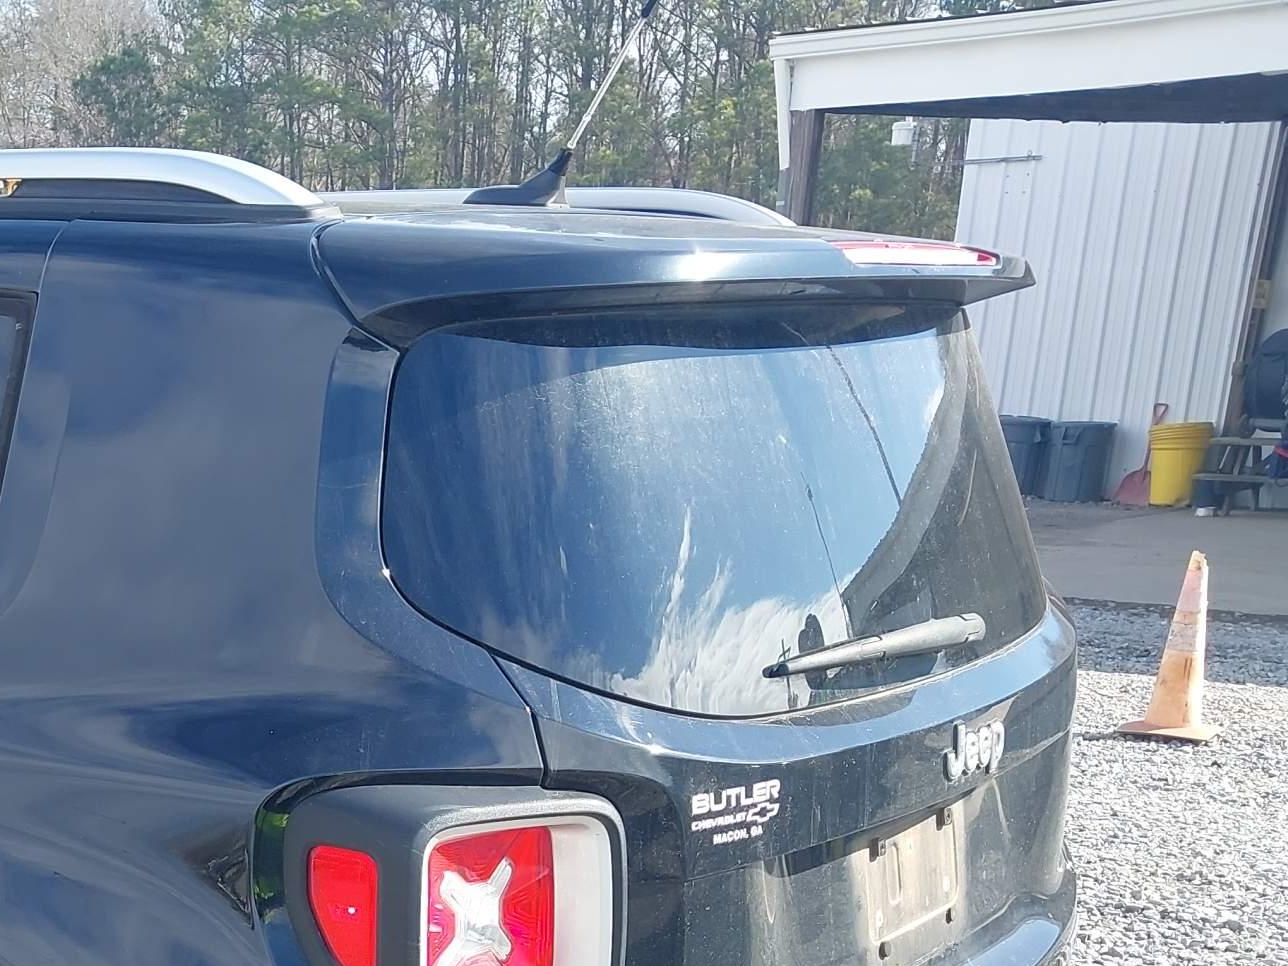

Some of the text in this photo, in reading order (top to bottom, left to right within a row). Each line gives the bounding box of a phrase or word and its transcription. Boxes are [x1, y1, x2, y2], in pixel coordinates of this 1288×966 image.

[943, 718, 1005, 781] Jeep
[692, 779, 781, 816] BUTLER
[750, 824, 763, 838] GA
